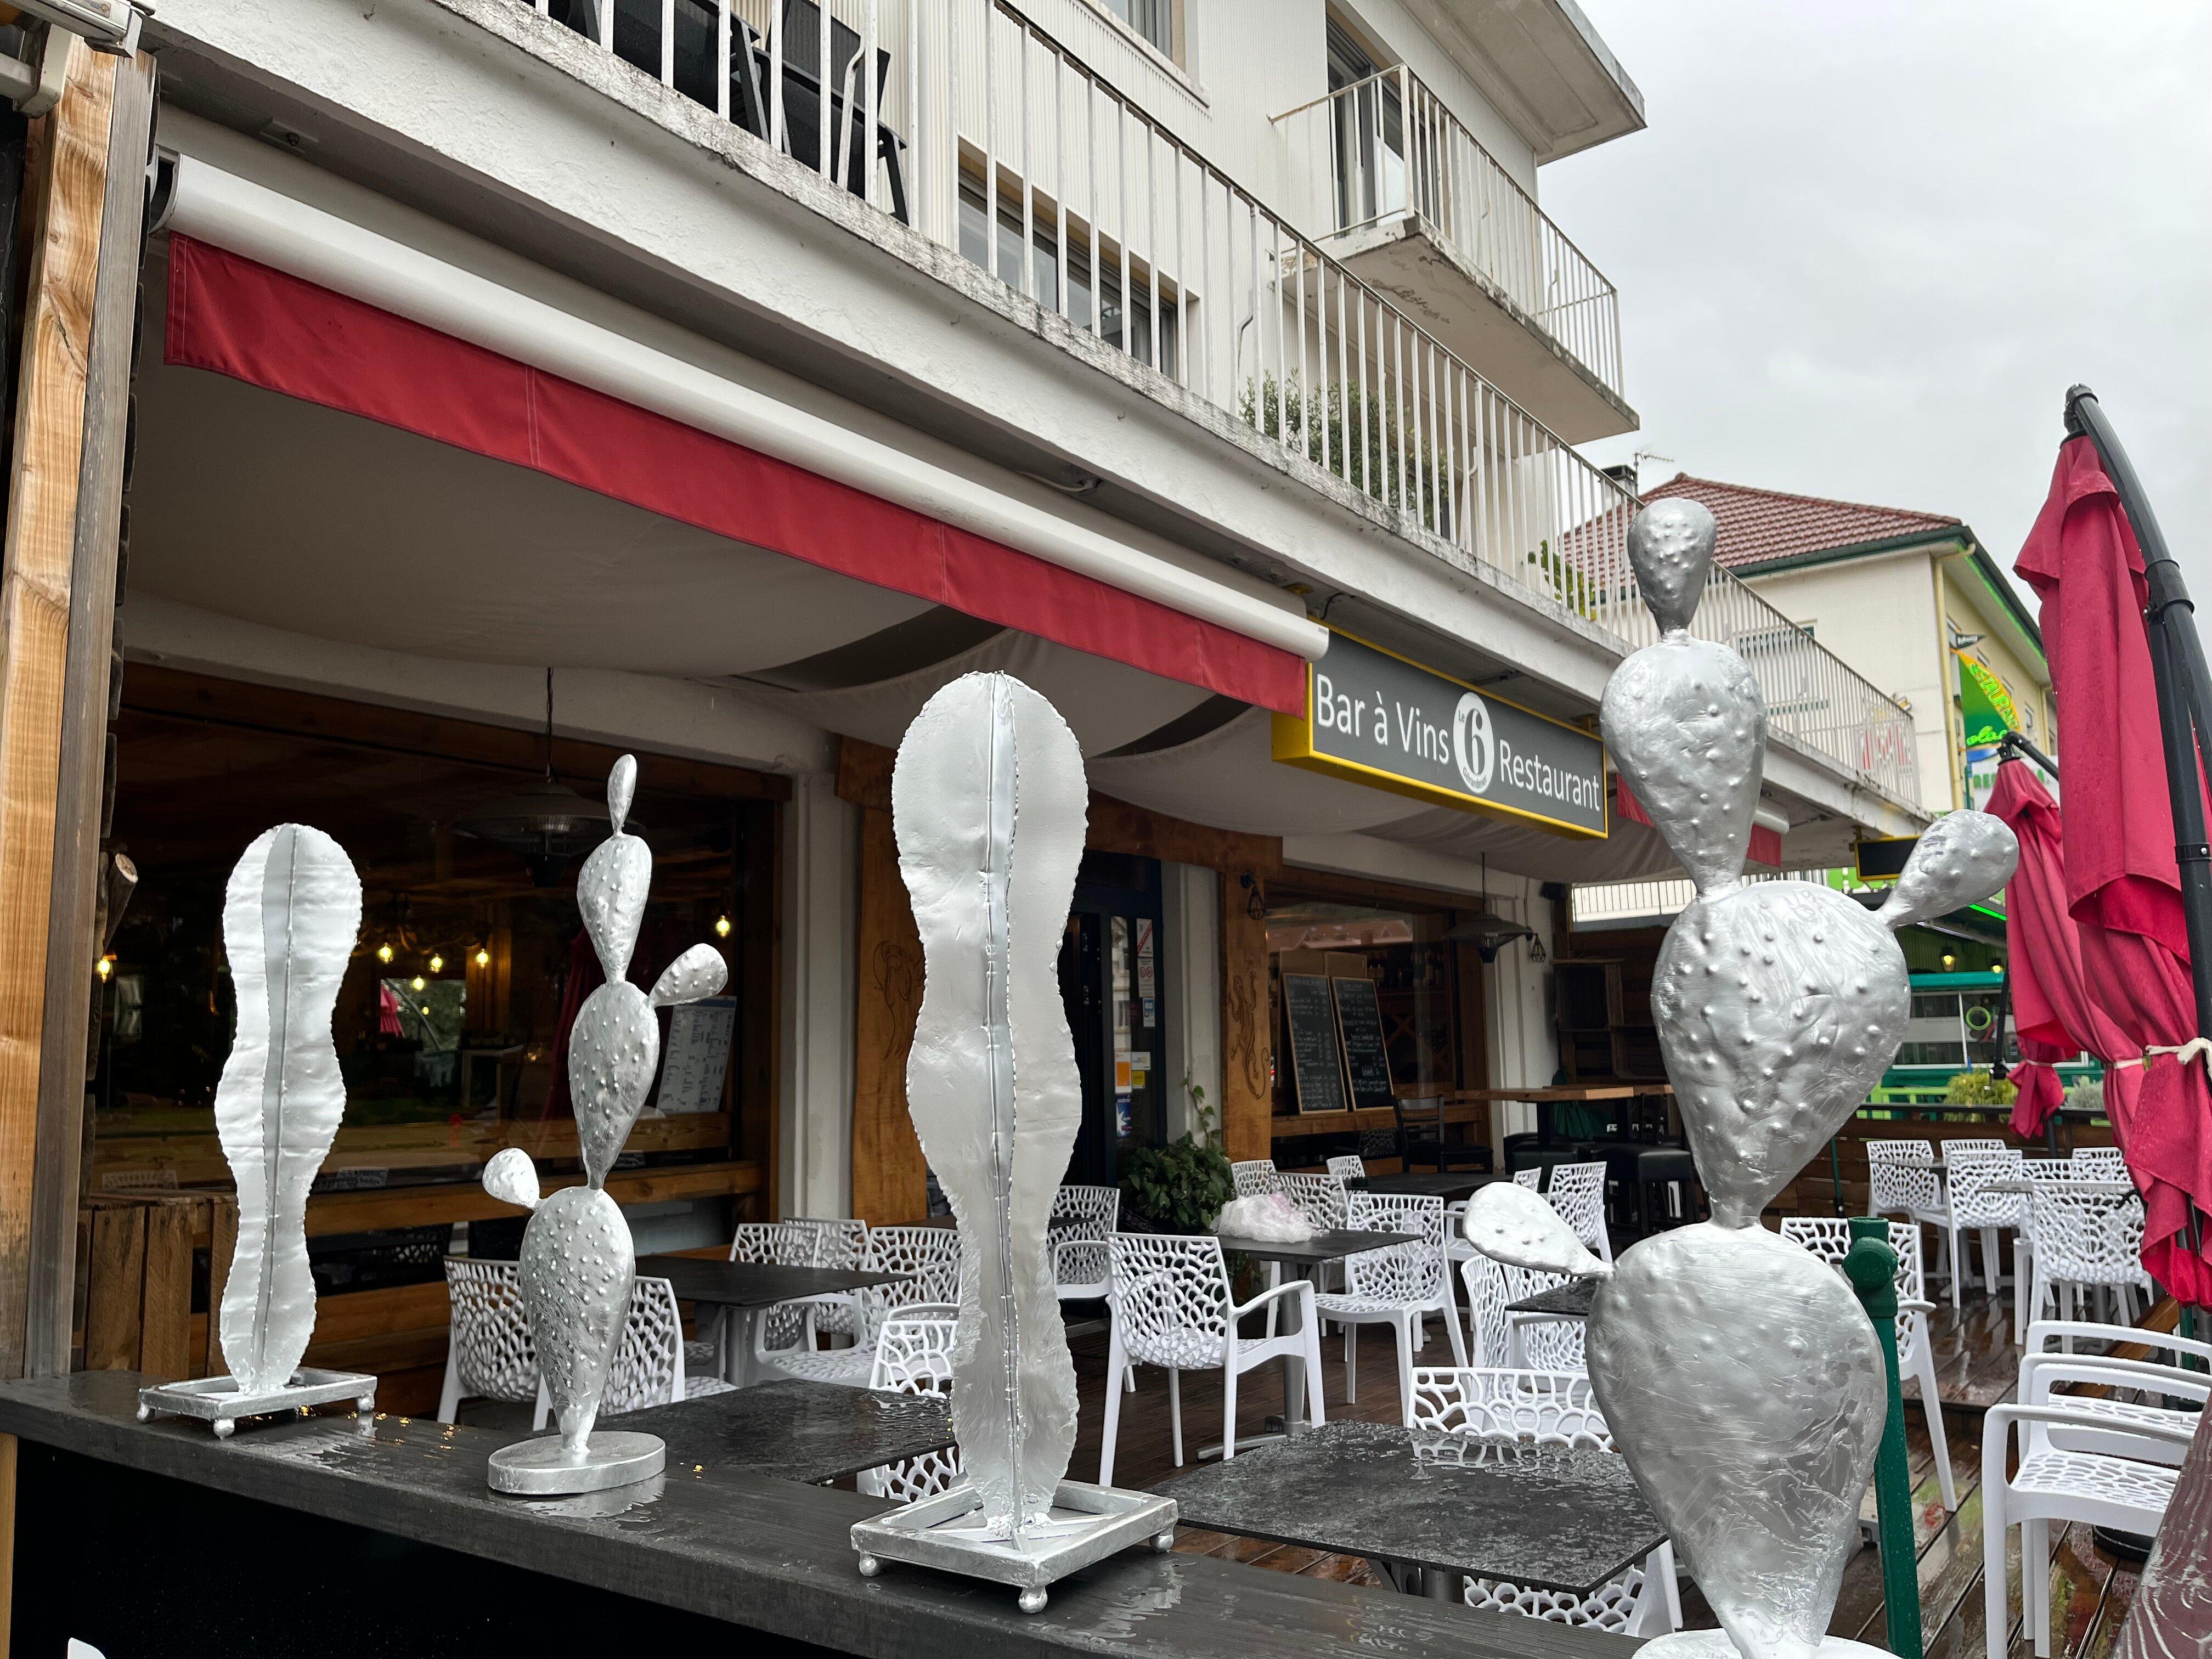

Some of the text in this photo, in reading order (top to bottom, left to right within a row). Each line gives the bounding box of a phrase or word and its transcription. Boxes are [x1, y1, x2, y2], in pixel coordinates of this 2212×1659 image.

[1317, 673, 1449, 764] Bar à Vins
[1458, 709, 1465, 723] Le
[1464, 708, 1485, 775] 6
[1500, 739, 1600, 812] Restaurant
